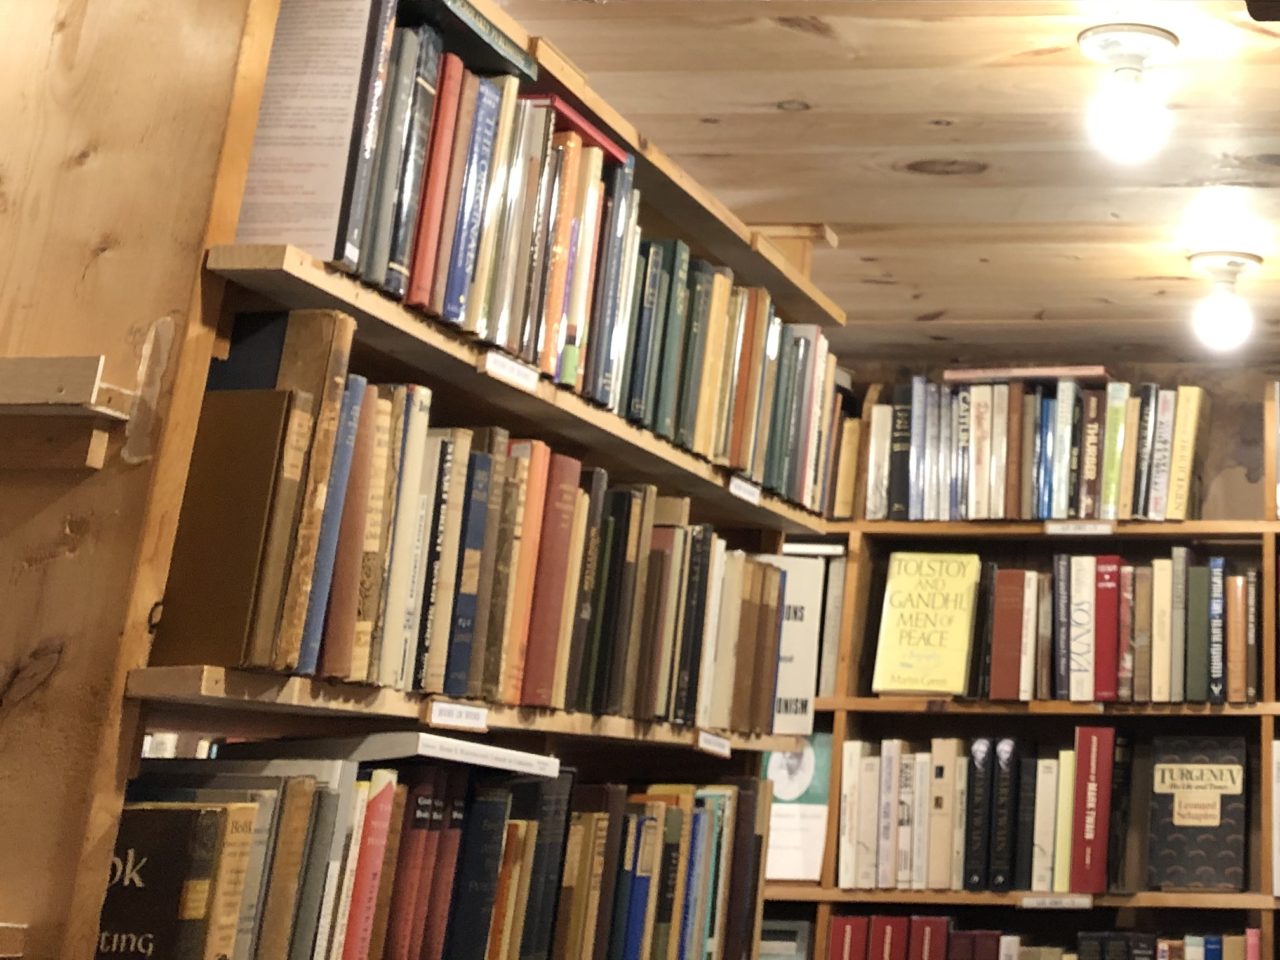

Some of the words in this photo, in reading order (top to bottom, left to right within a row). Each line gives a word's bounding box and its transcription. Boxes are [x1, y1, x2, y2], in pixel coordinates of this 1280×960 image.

[1082, 421, 1100, 480] THURBER
[896, 559, 970, 577] TOLSTOY
[915, 579, 946, 591] AND
[896, 613, 938, 628] MEN
[940, 615, 954, 626] OF
[899, 629, 948, 647] PEACE
[1069, 601, 1091, 672] SONYA
[1160, 768, 1242, 785] TURGENEV
